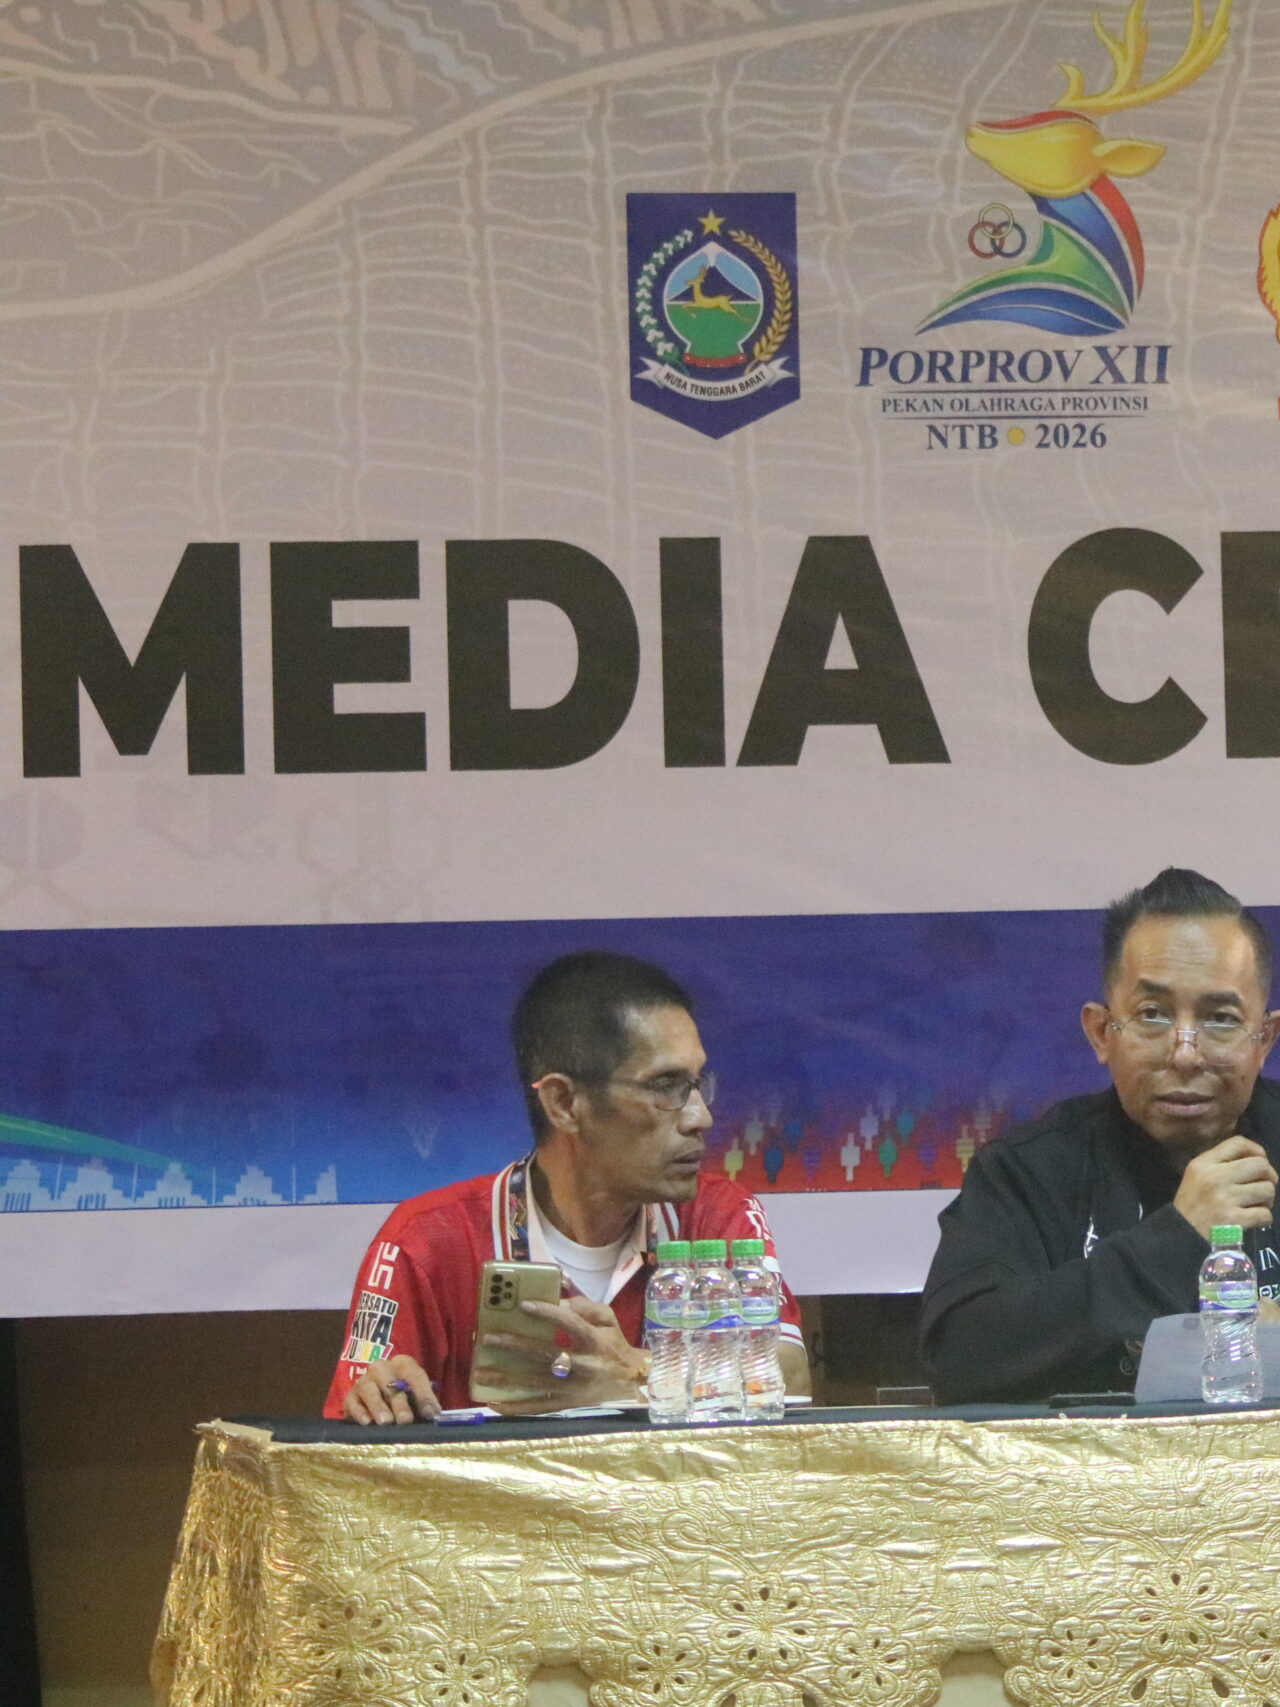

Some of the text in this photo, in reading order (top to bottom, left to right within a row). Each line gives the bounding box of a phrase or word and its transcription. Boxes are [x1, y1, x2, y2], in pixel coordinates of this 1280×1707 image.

[856, 345, 1173, 387] PORPROV XII
[663, 370, 767, 398] NUSA TENGGARA BARAT
[881, 396, 1148, 413] PEKAN OLAHRAGA PROVINSI
[926, 422, 1108, 450] NTB 2026
[19, 536, 951, 779] MEDIA
